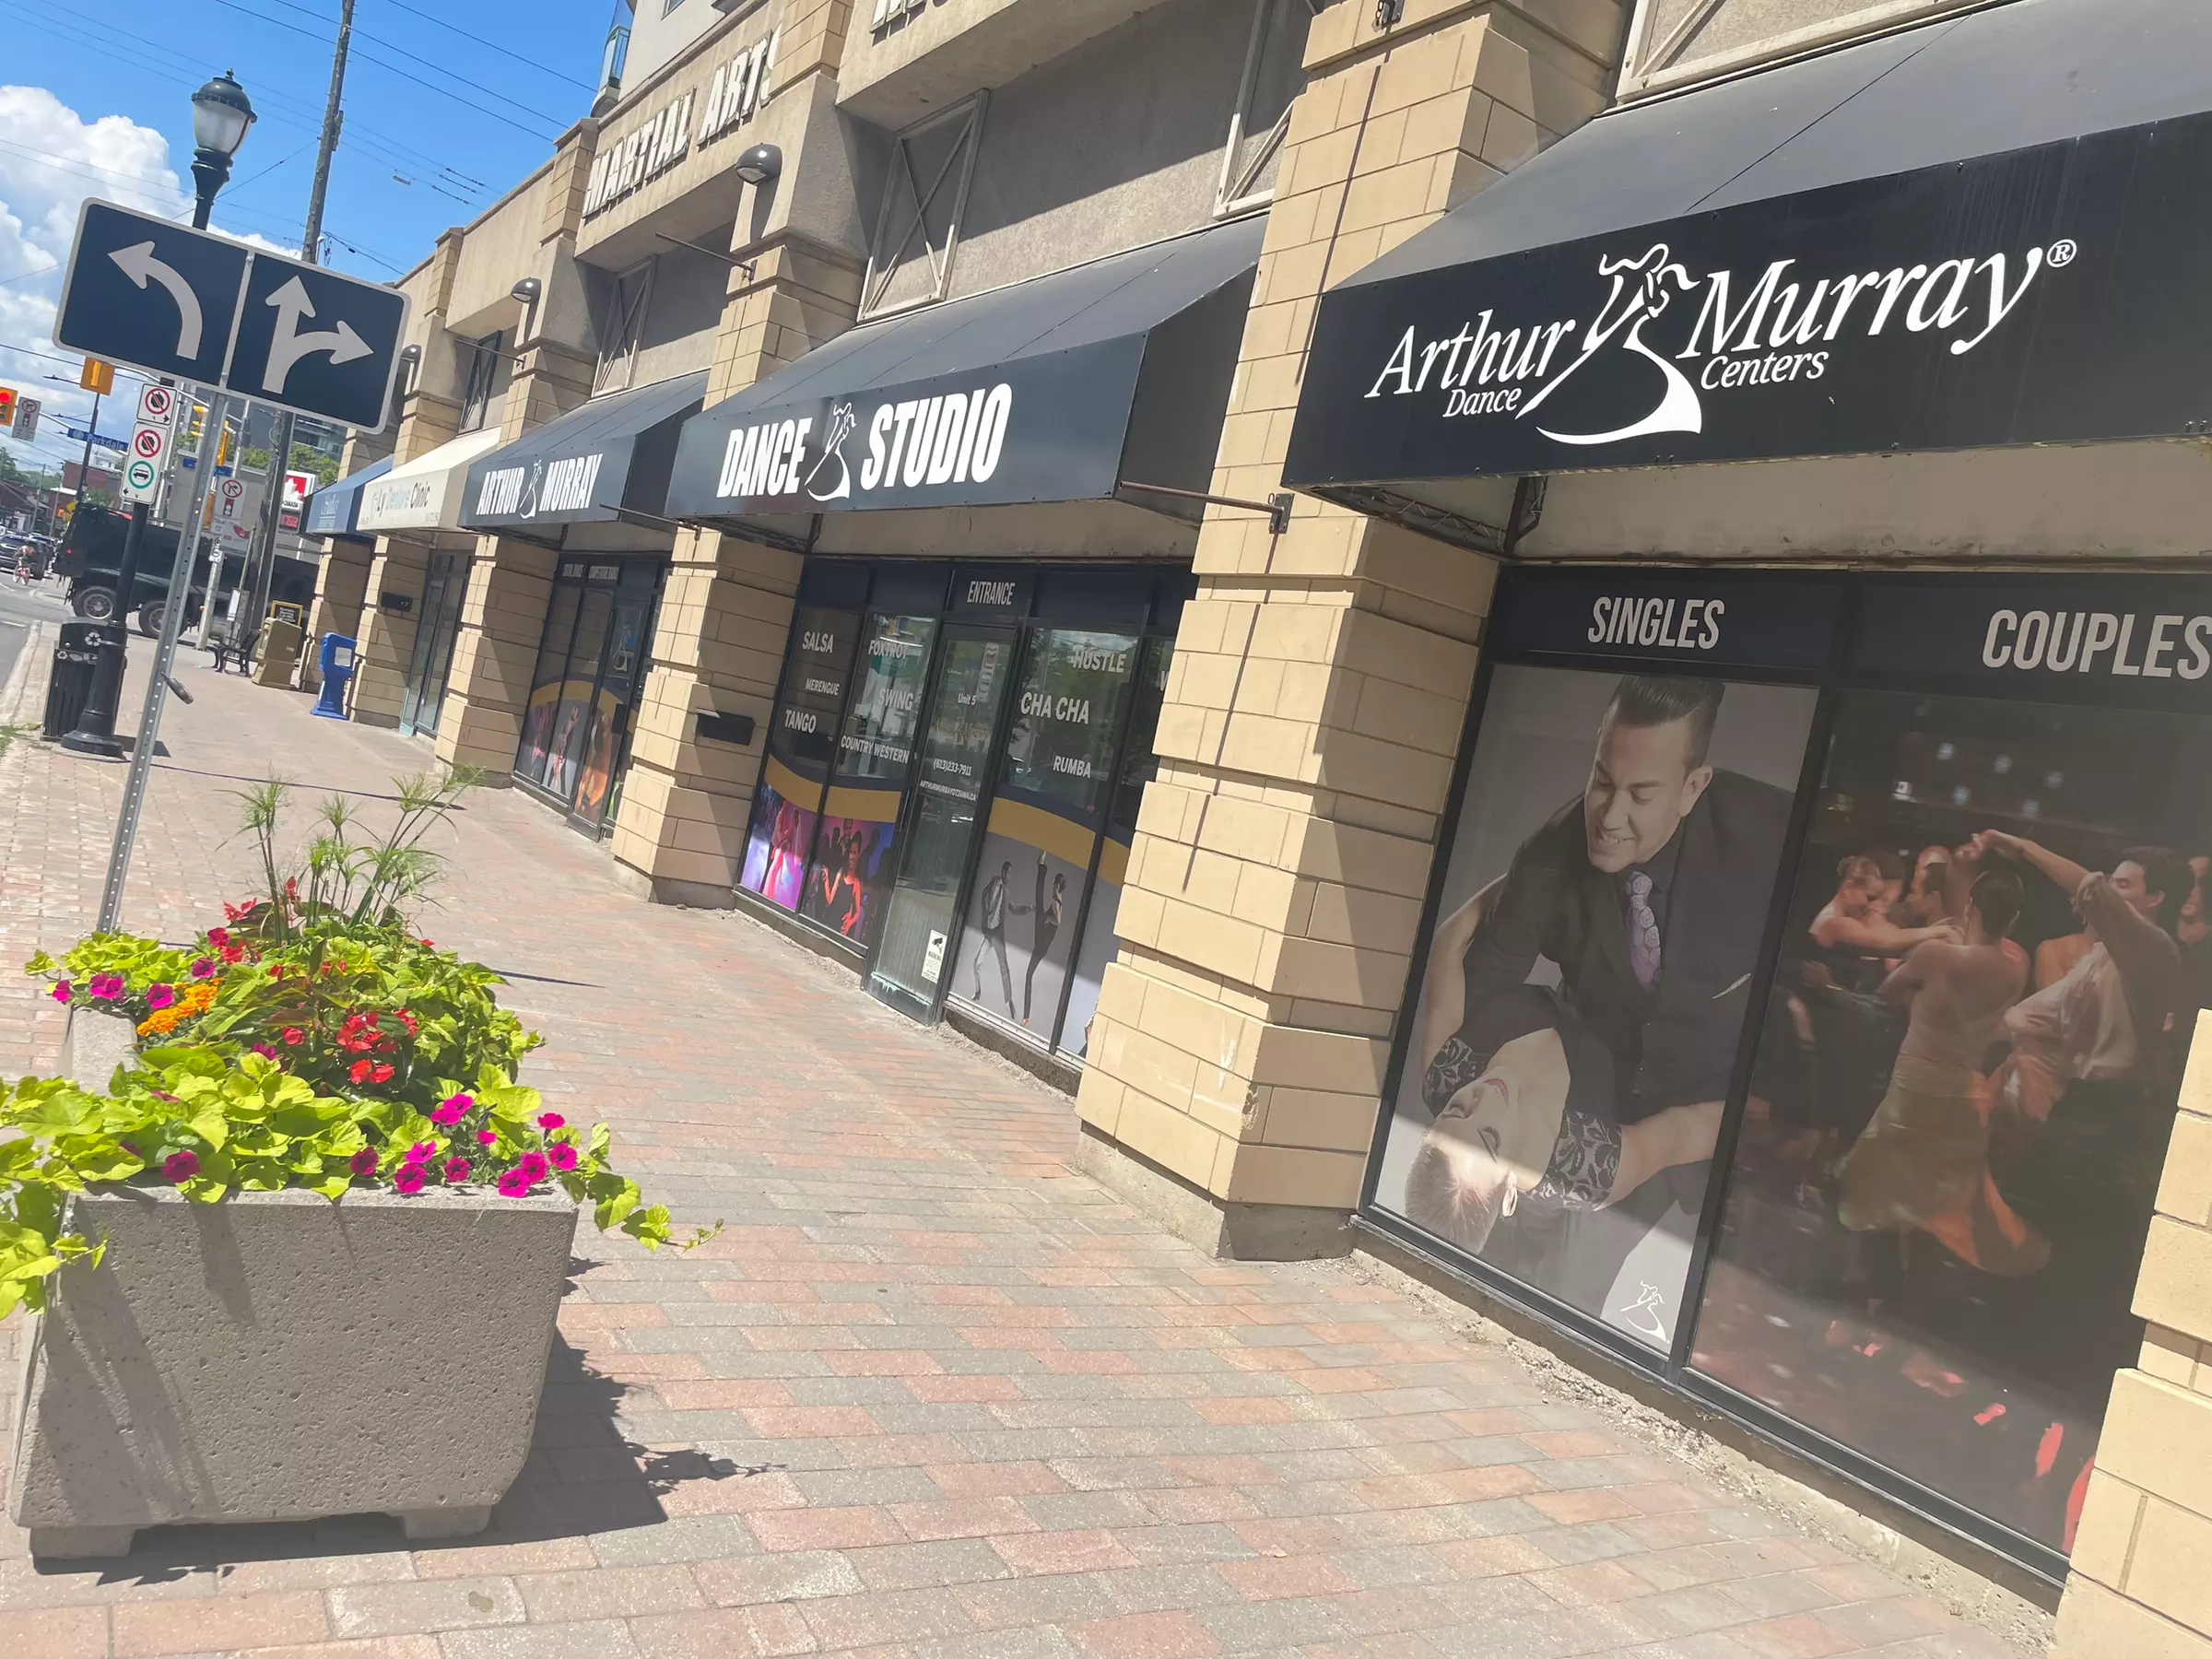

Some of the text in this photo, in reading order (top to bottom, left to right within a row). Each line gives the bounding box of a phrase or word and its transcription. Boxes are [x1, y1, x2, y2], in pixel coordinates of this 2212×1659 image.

[582, 90, 693, 216] MARTIAL
[1364, 308, 1577, 398] Arthur
[1441, 350, 1830, 418] Dance Centers
[87, 433, 125, 451] Parkdale
[715, 382, 1013, 499] DANCE STUDIO
[410, 480, 431, 510] Clinic
[476, 453, 604, 516] ARTHUR MURRAY
[966, 580, 1016, 607] ENTRANCE
[1587, 595, 1726, 650] SINGLES
[802, 630, 834, 653] SALSA
[867, 640, 910, 660] FOXTROT
[1982, 609, 2212, 680] COUPLES
[1072, 648, 1127, 674] HUSTLE
[805, 677, 841, 697] MERENGUE
[878, 688, 914, 712] SWING
[958, 692, 977, 706] Unit 5
[1020, 691, 1090, 724] CHA CHA
[784, 709, 818, 735] TANGO
[841, 735, 911, 764] COUNTRY WESTERN
[933, 759, 972, 776] (613)233-7911
[1053, 755, 1092, 779] RUMBA
